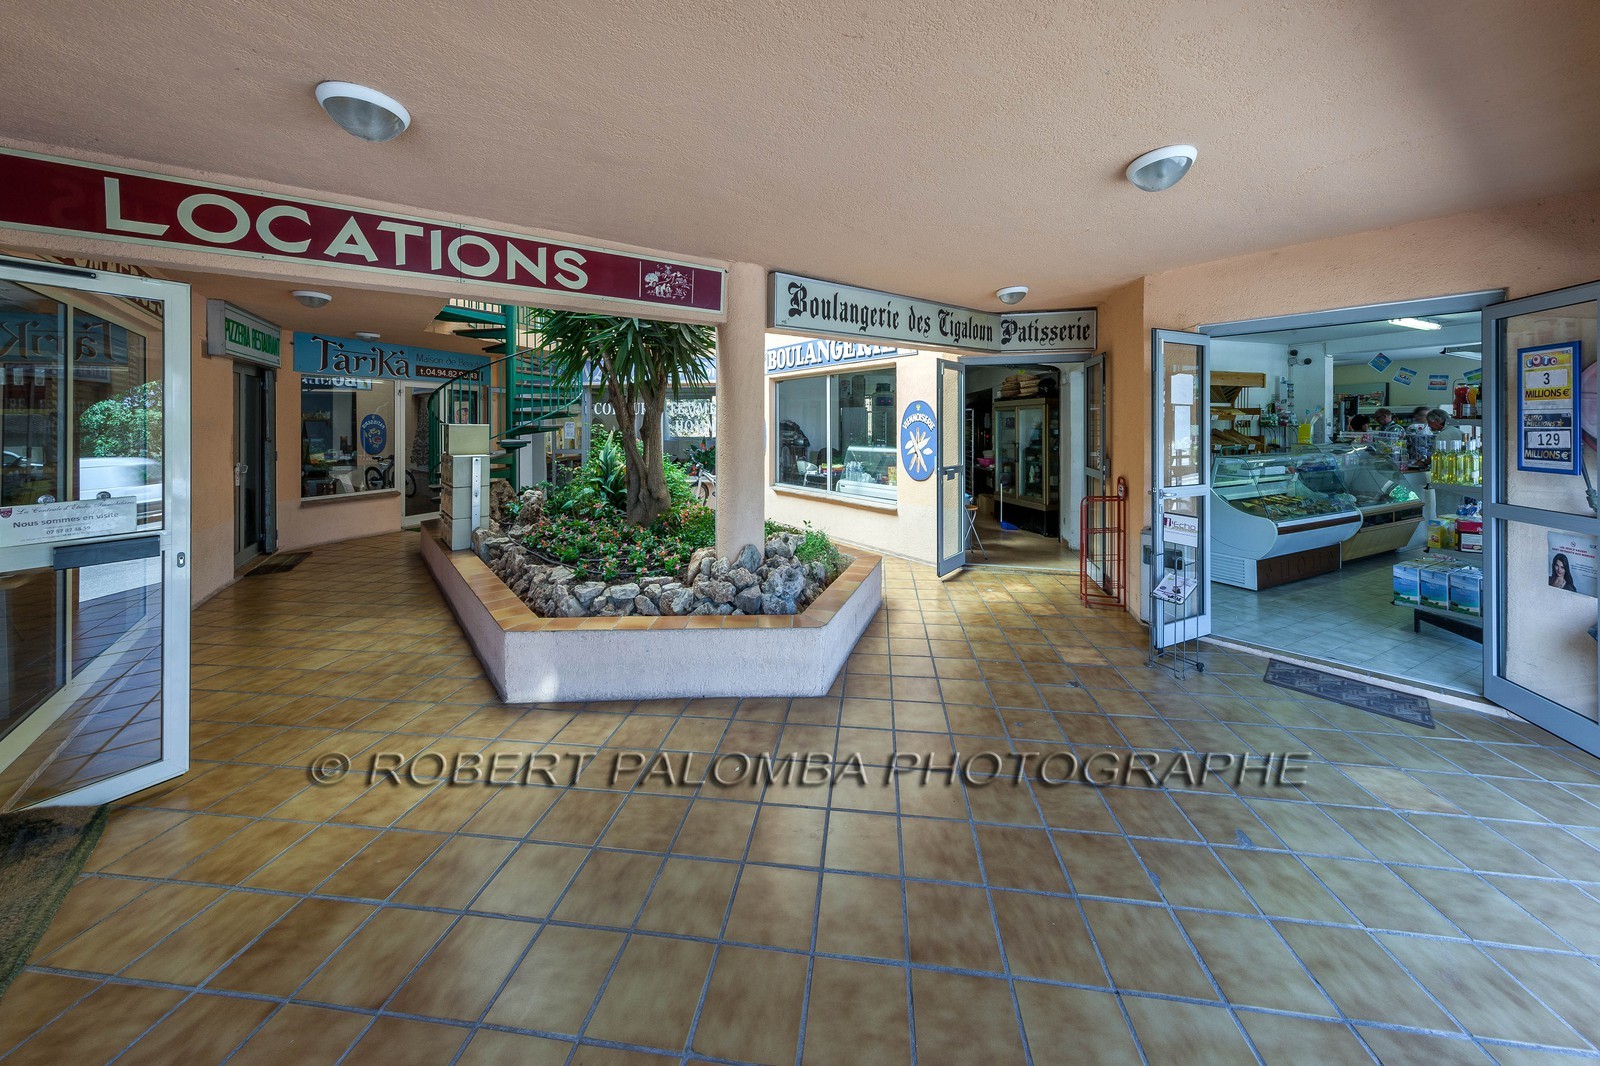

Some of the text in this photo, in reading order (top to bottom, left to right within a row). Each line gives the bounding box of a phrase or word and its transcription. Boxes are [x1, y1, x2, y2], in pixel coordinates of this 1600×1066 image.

[104, 176, 589, 290] LOCATIONS
[788, 282, 899, 332] Boulangerie
[908, 305, 931, 338] des
[1001, 317, 1090, 346] Patisserie
[252, 328, 280, 356] RESTAURANT
[416, 353, 444, 365] Maison
[1543, 372, 1550, 385] 3
[1525, 389, 1561, 398] MILLIONS
[1537, 433, 1560, 446] 129
[1525, 450, 1560, 460] MILLIONS
[41, 517, 81, 526] sommes
[96, 511, 120, 519] visite
